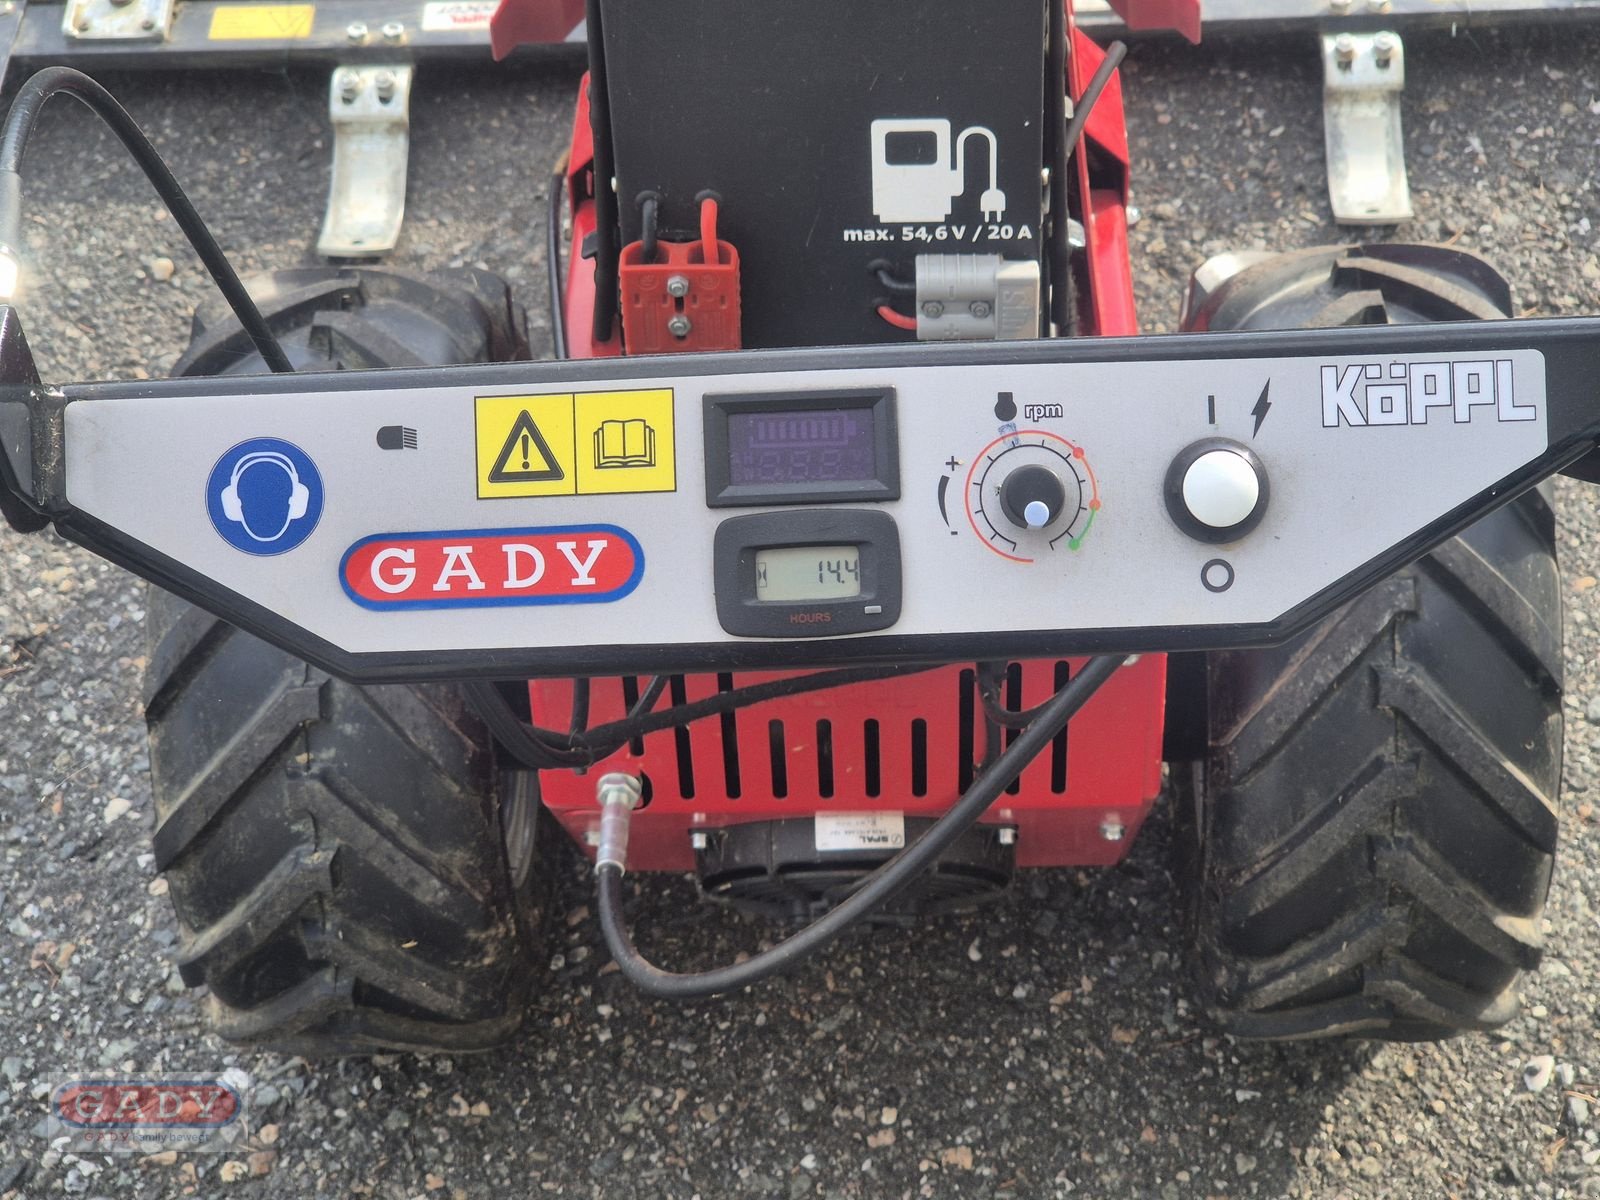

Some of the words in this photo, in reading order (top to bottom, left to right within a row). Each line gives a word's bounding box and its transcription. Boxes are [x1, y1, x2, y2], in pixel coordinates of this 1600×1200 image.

[843, 228, 894, 242] max.
[901, 225, 948, 243] 54,6
[951, 225, 966, 240] V
[972, 225, 982, 241] /
[987, 225, 1013, 240] 20
[1017, 224, 1033, 239] A
[1024, 400, 1063, 420] rpm
[371, 540, 607, 593] GADY
[818, 559, 858, 584] 14.4
[789, 612, 832, 624] HOURS
